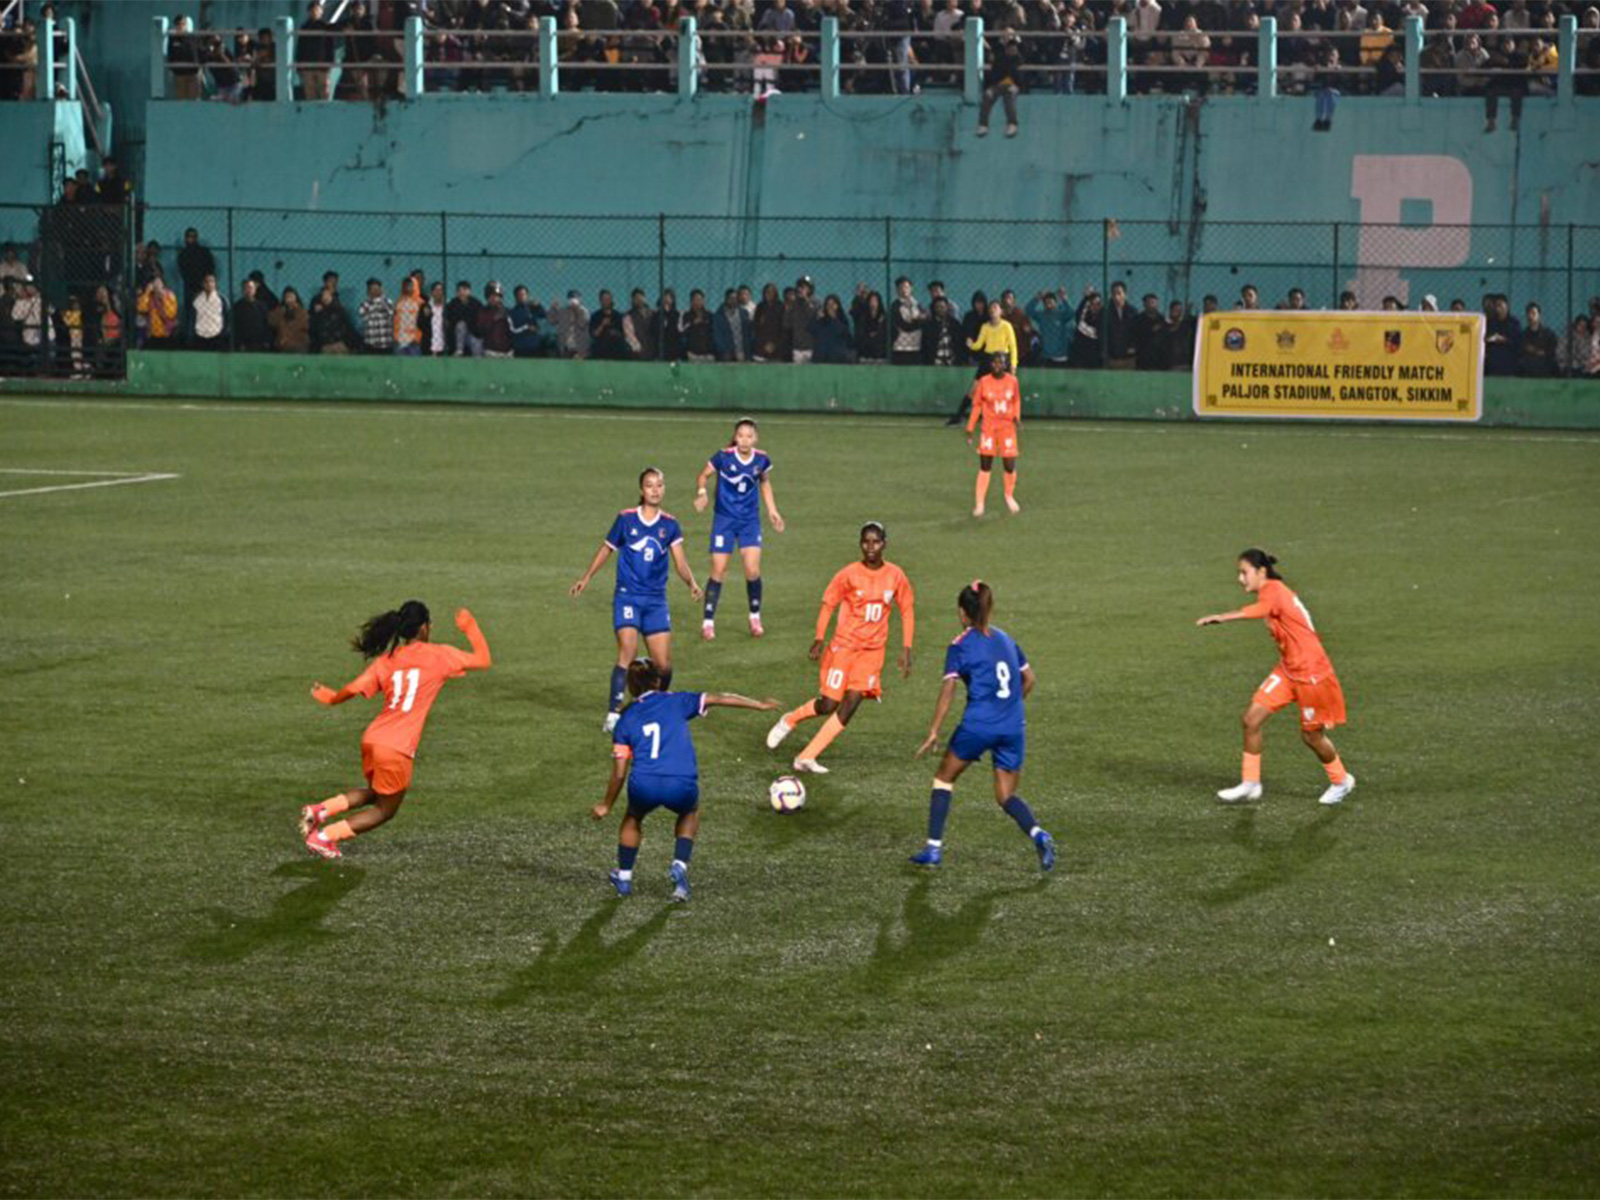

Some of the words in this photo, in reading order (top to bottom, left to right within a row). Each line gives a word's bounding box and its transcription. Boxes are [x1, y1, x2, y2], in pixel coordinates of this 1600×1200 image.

[1231, 363, 1330, 379] INTERNATIONAL
[1333, 364, 1394, 380] FRIENDLY
[1399, 365, 1445, 381] MATCH
[1222, 384, 1270, 399] PALJOR
[1273, 385, 1336, 402] STADIUM,
[1340, 386, 1402, 402] GANGTOK,
[1406, 387, 1453, 402] SIKKIM
[864, 602, 883, 622] 10
[826, 667, 843, 689] 10
[995, 660, 1011, 699] 9
[388, 667, 420, 712] 11
[642, 721, 661, 759] 7
